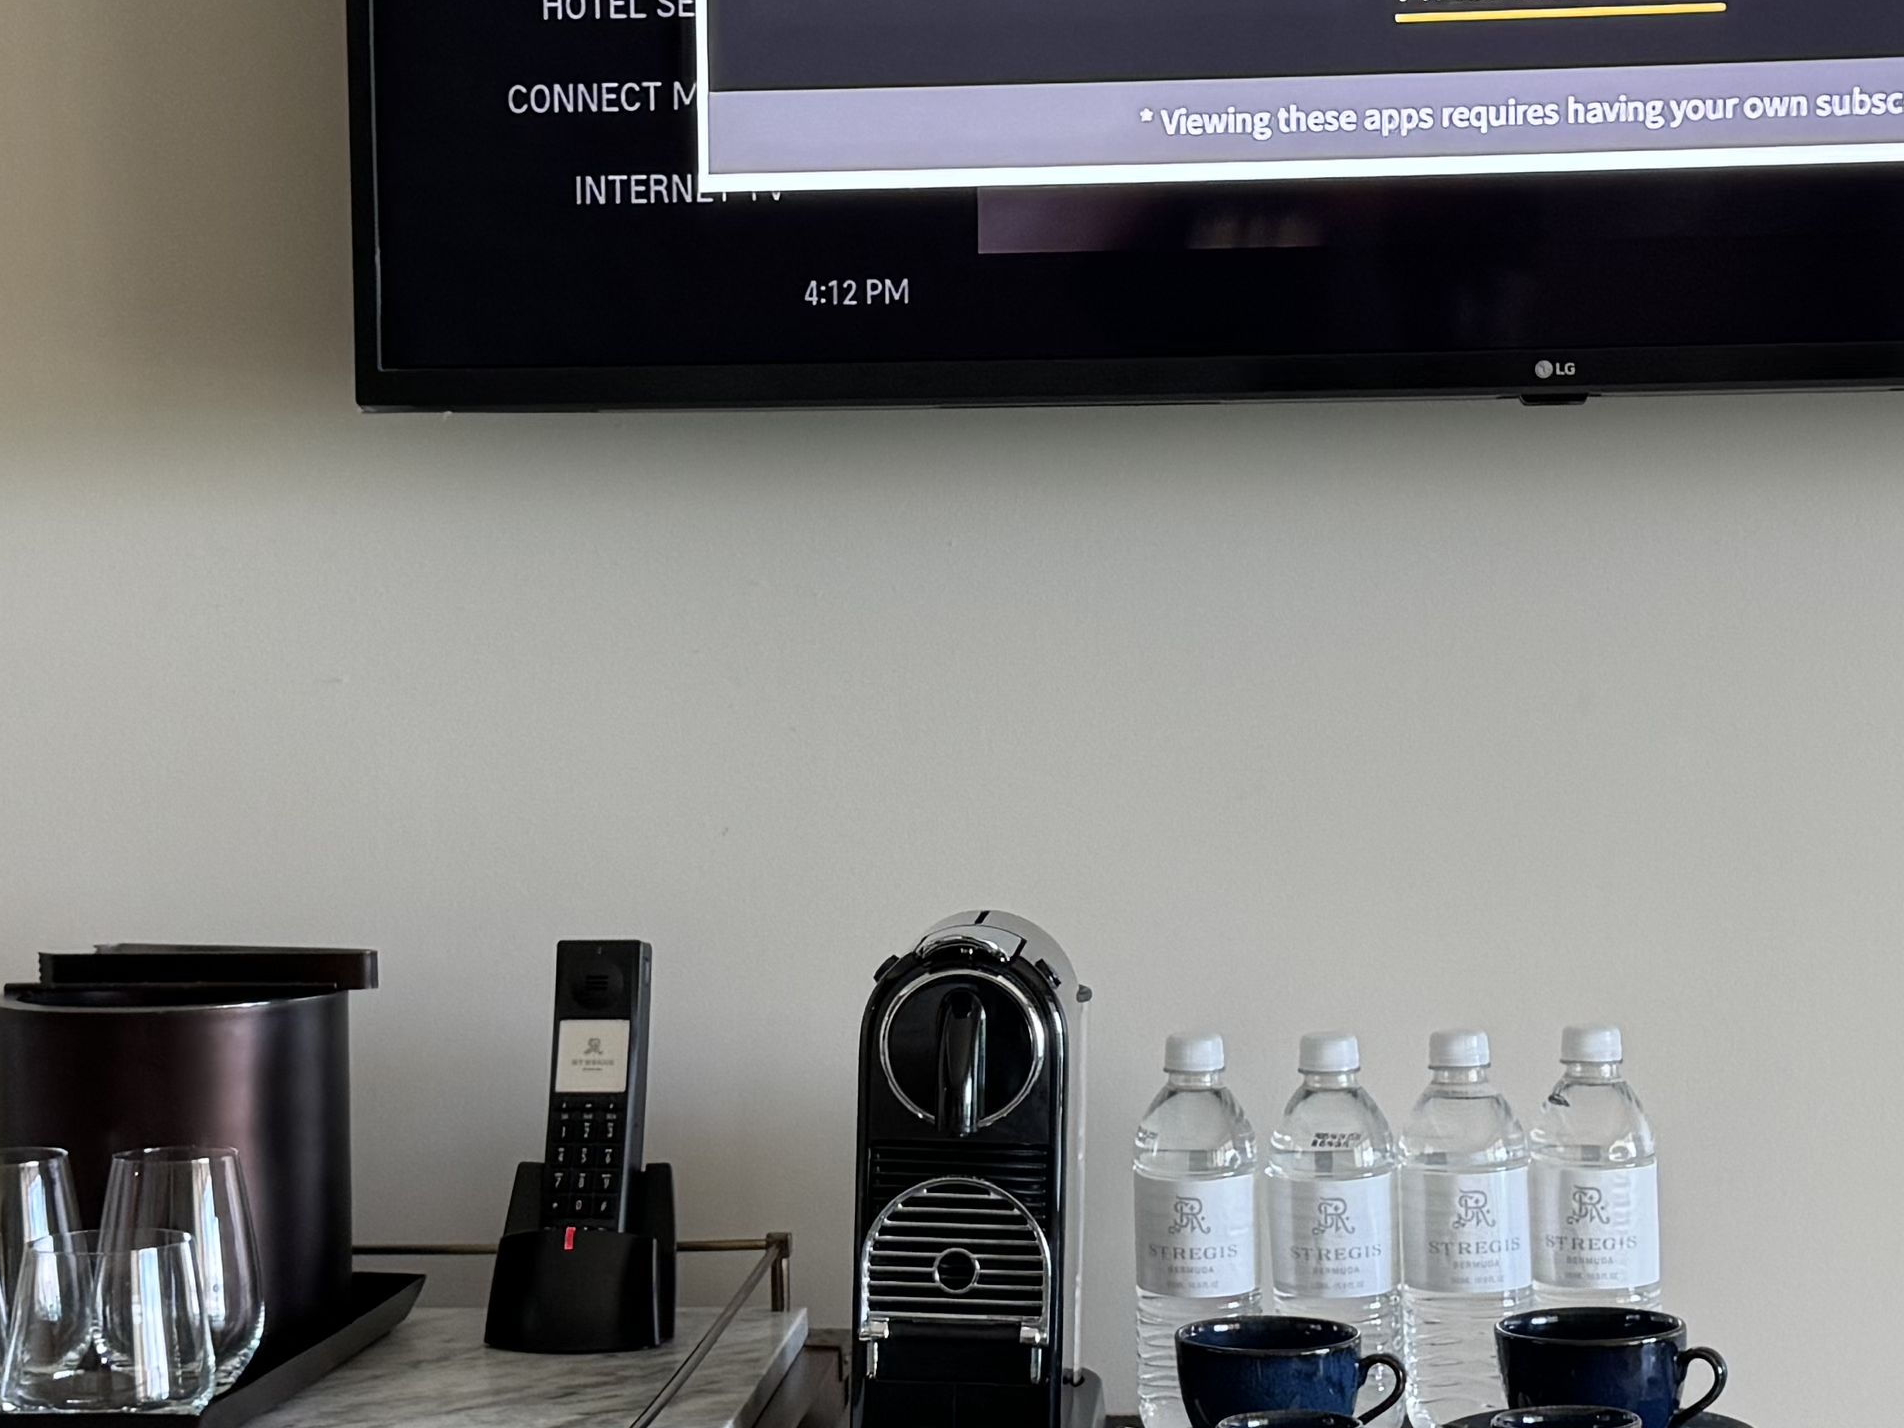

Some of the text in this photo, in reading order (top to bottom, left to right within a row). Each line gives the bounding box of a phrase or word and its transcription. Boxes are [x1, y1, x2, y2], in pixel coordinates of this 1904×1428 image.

[508, 81, 663, 114] CONNECT
[1160, 106, 1273, 141] Viewing
[1277, 104, 1357, 133] these
[1363, 107, 1434, 137] apps
[1442, 97, 1560, 134] requires
[1567, 94, 1666, 130] having
[1669, 97, 1740, 128] your
[1743, 95, 1808, 119] own
[575, 174, 728, 205] INTERN
[804, 278, 909, 306] 4:12 PM
[1555, 362, 1576, 376] LG
[1173, 1244, 1238, 1260] REGIS
[1317, 1243, 1382, 1261] REGIS
[1458, 1237, 1520, 1255] REGIS
[1571, 1235, 1637, 1251] REGIS
